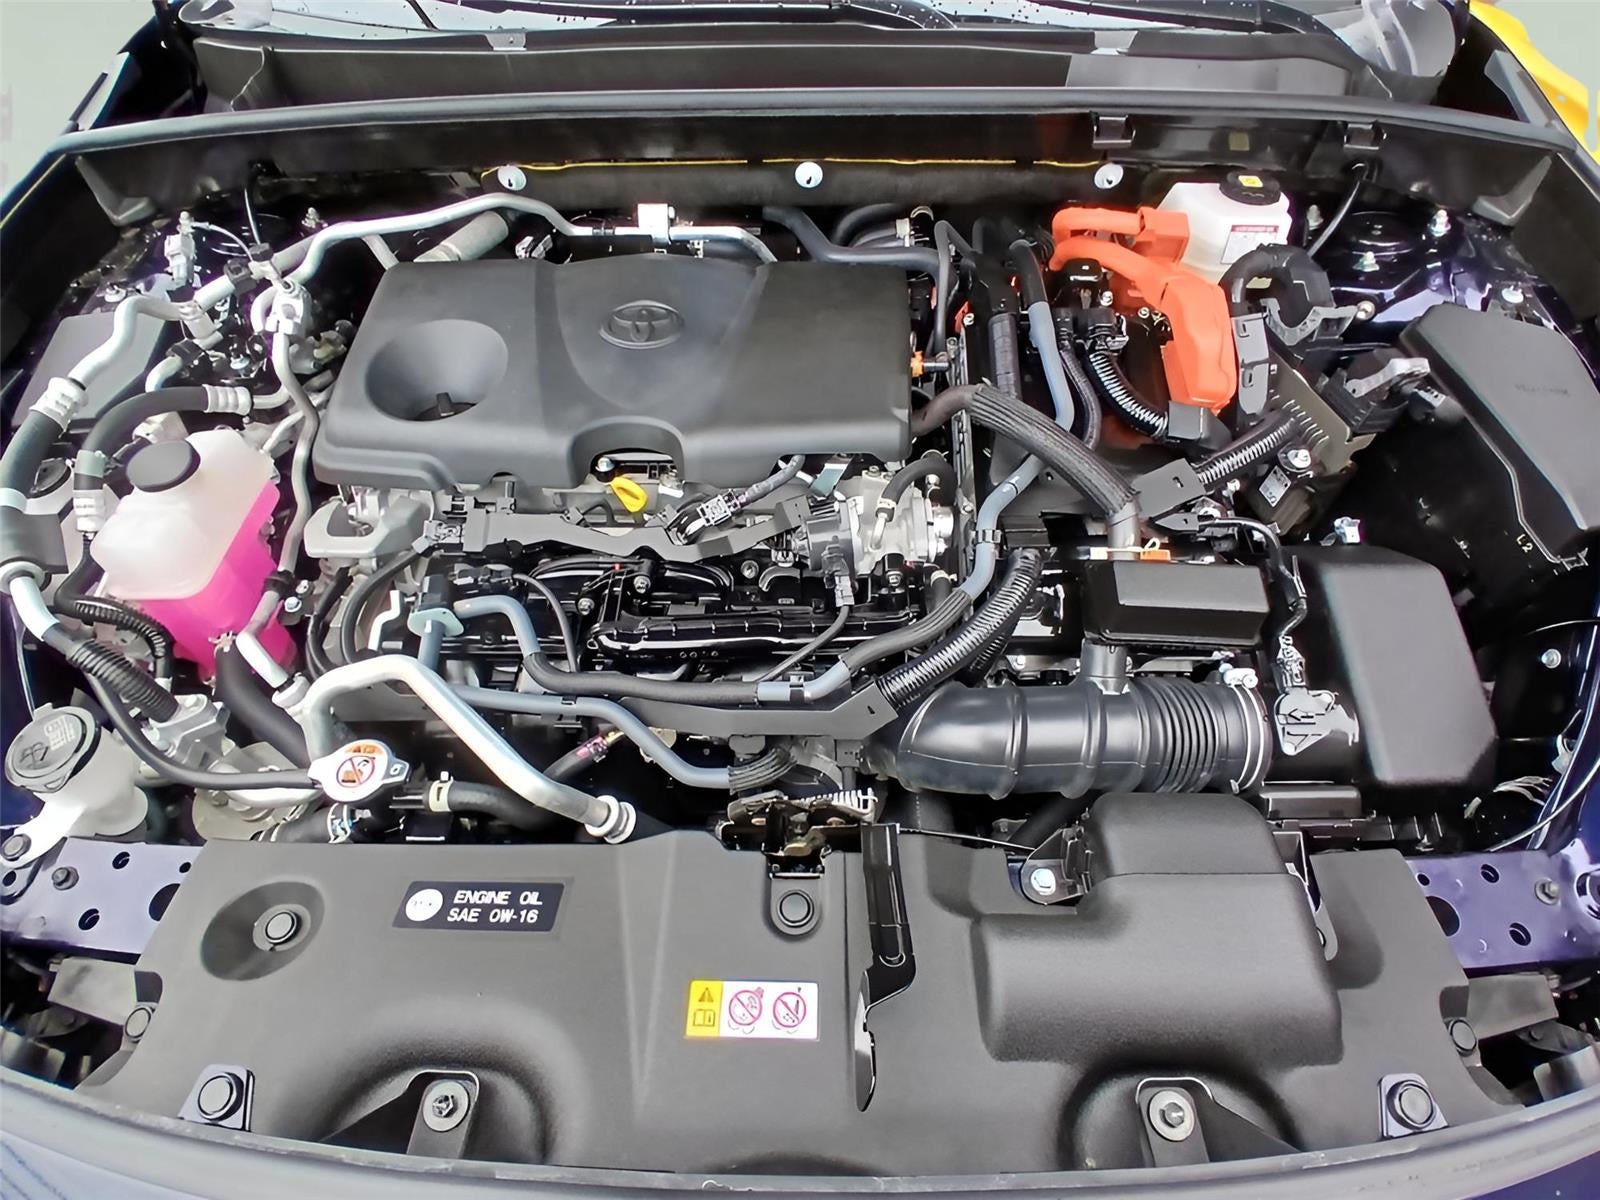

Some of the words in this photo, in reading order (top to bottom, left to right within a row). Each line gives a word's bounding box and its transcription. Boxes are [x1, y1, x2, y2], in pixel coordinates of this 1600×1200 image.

[453, 890, 511, 905] ENGINE
[519, 891, 543, 906] OIL
[447, 908, 481, 923] SAE
[489, 909, 539, 923] 0W-16
